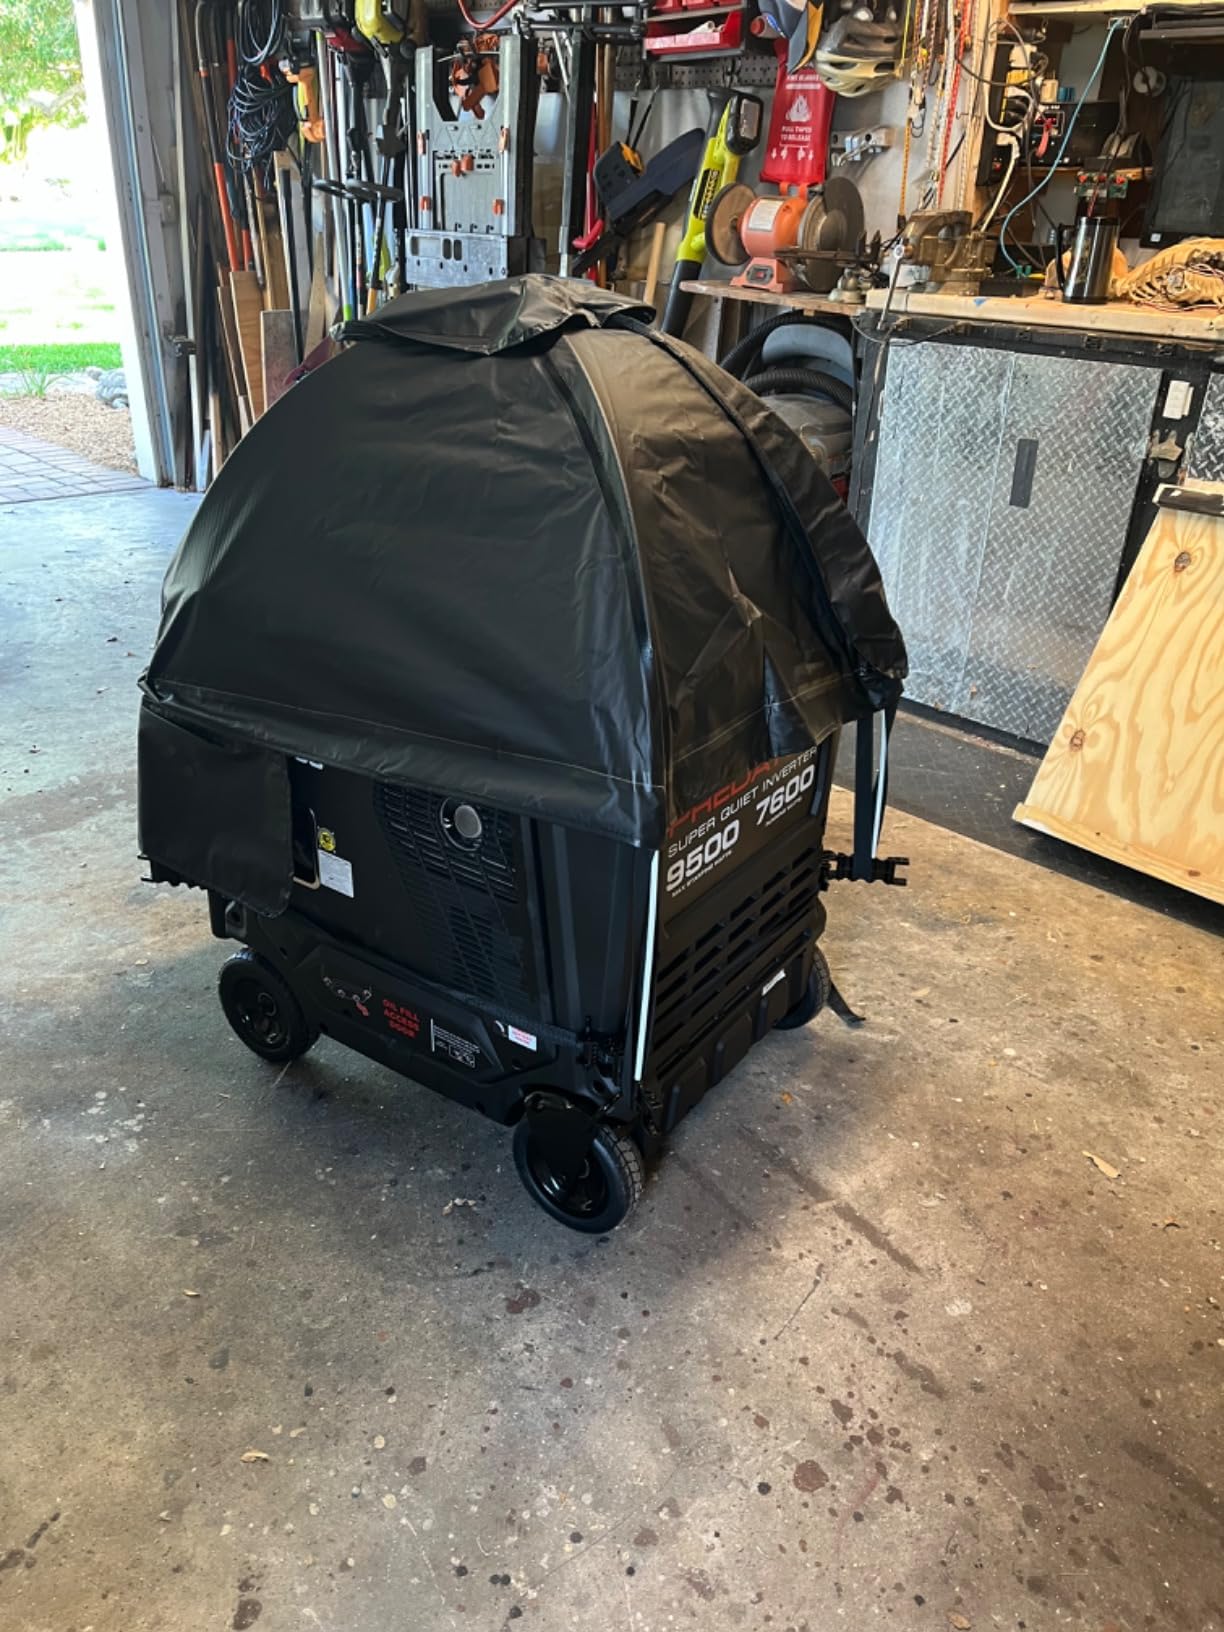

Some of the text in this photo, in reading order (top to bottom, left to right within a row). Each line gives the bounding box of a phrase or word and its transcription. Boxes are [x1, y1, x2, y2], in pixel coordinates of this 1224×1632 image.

[666, 764, 815, 892] 9500 7600
[668, 746, 818, 858] SUPER QUIET INVERTER
